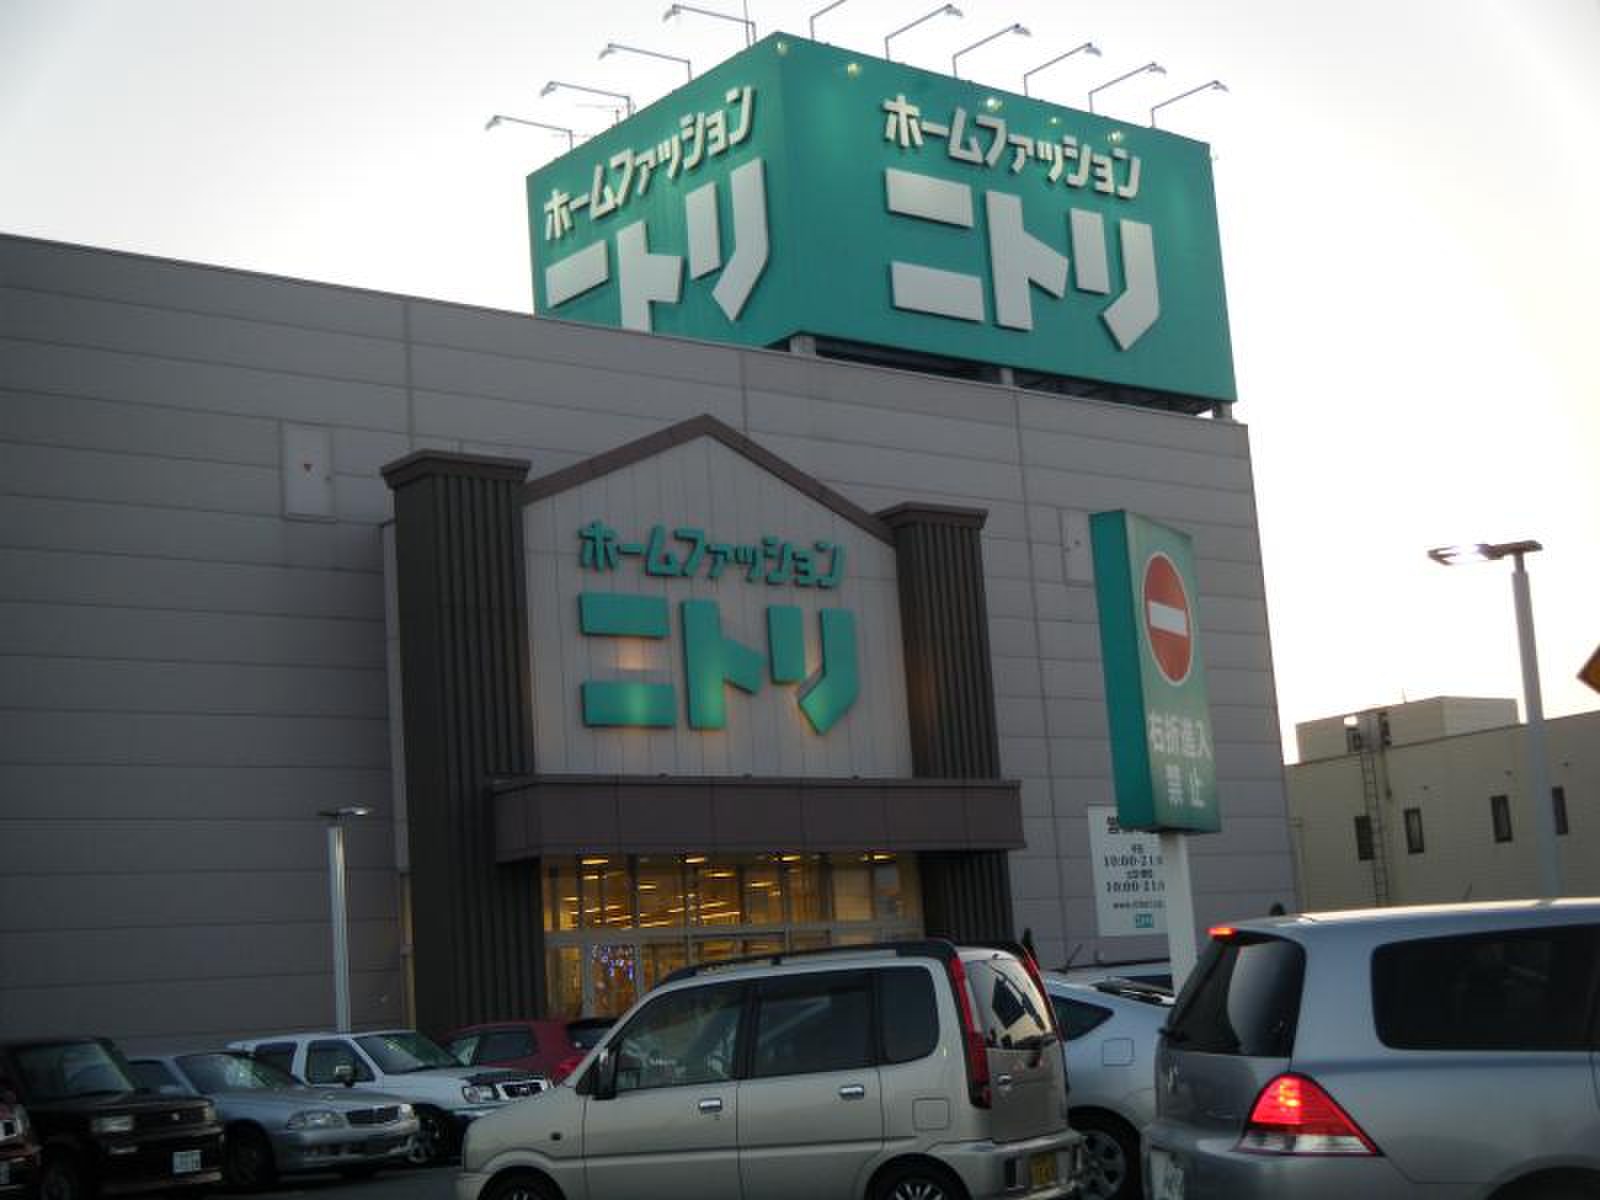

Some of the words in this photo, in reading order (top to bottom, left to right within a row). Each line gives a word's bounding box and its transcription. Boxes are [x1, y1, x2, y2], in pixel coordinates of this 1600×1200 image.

[544, 86, 755, 241] ホームファッション
[882, 94, 1141, 199] ホームファッション
[545, 157, 770, 333] ニトリ
[884, 167, 1160, 352] ニトリ
[578, 521, 845, 588] ホームファッション
[578, 592, 859, 735] ニトリ
